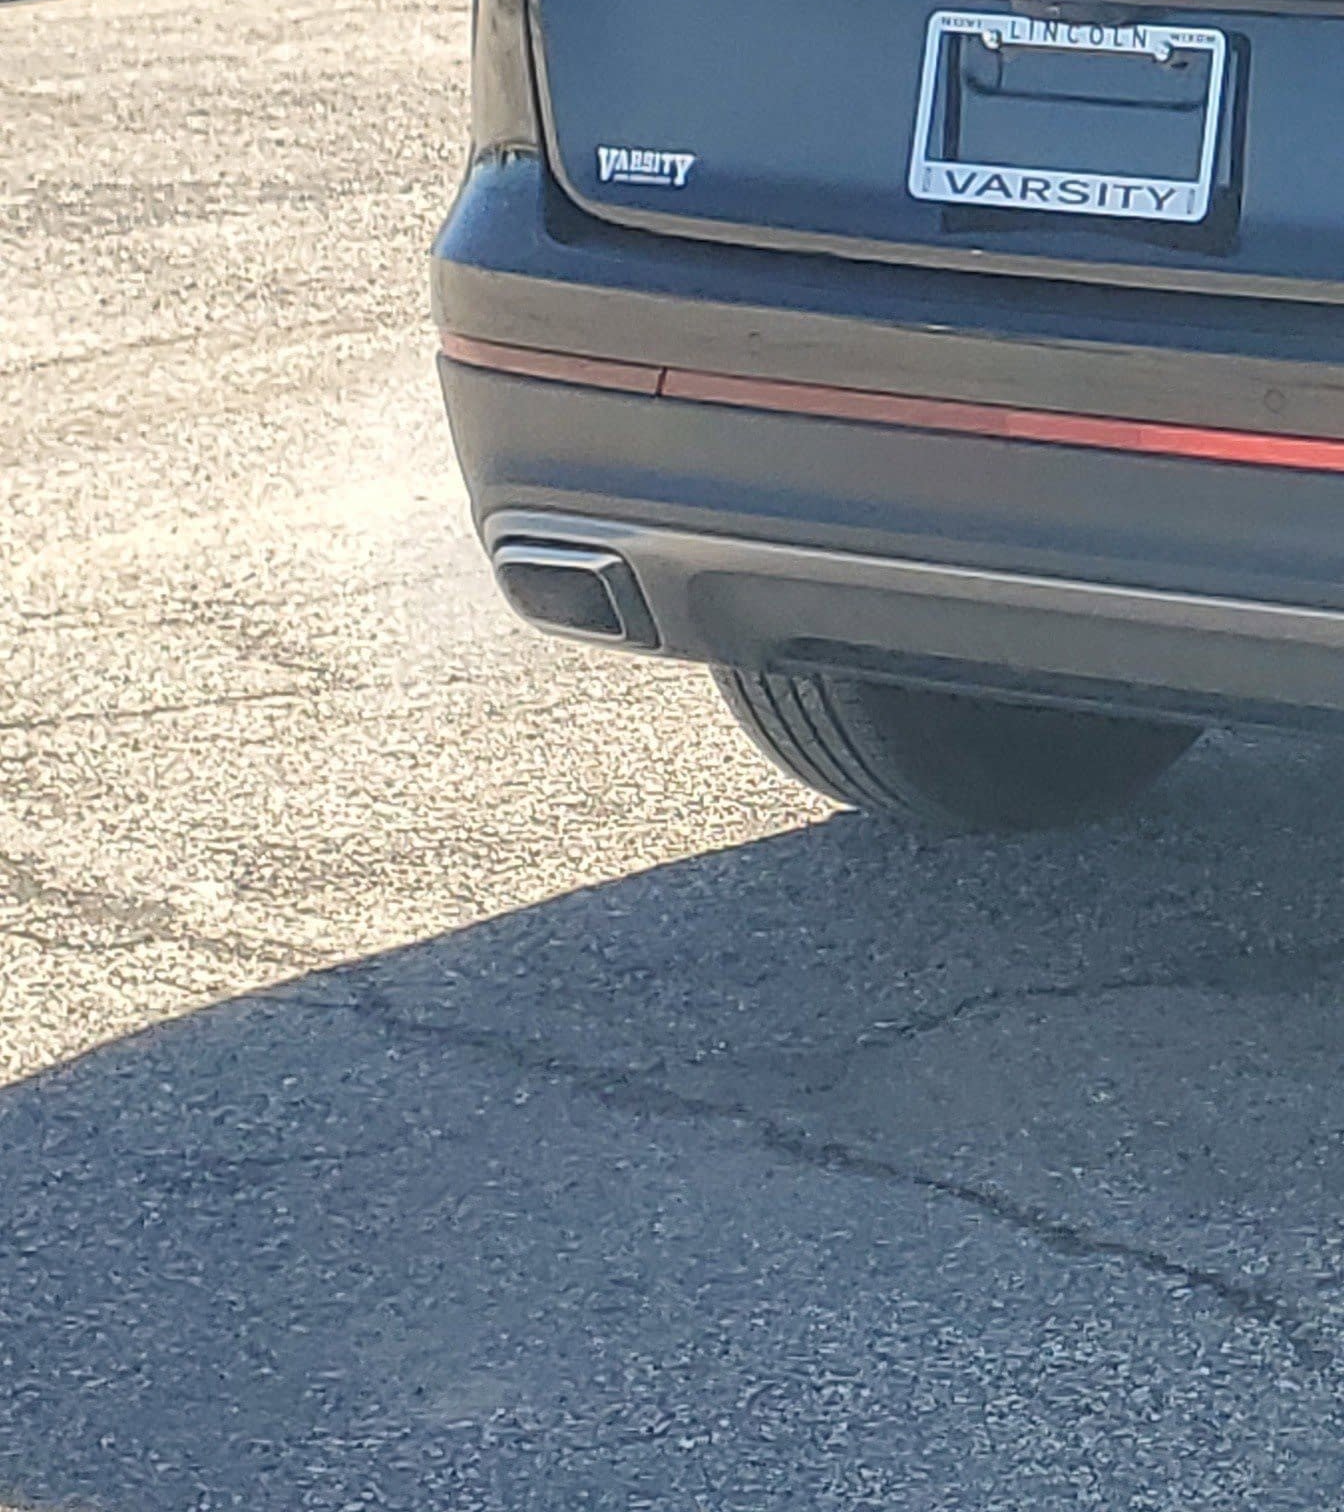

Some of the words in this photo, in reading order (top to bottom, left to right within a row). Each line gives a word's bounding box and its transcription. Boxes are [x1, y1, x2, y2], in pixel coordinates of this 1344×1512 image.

[1010, 19, 1147, 49] LINCOLN
[597, 146, 697, 187] VARSITY
[945, 169, 1177, 212] VARSITY
